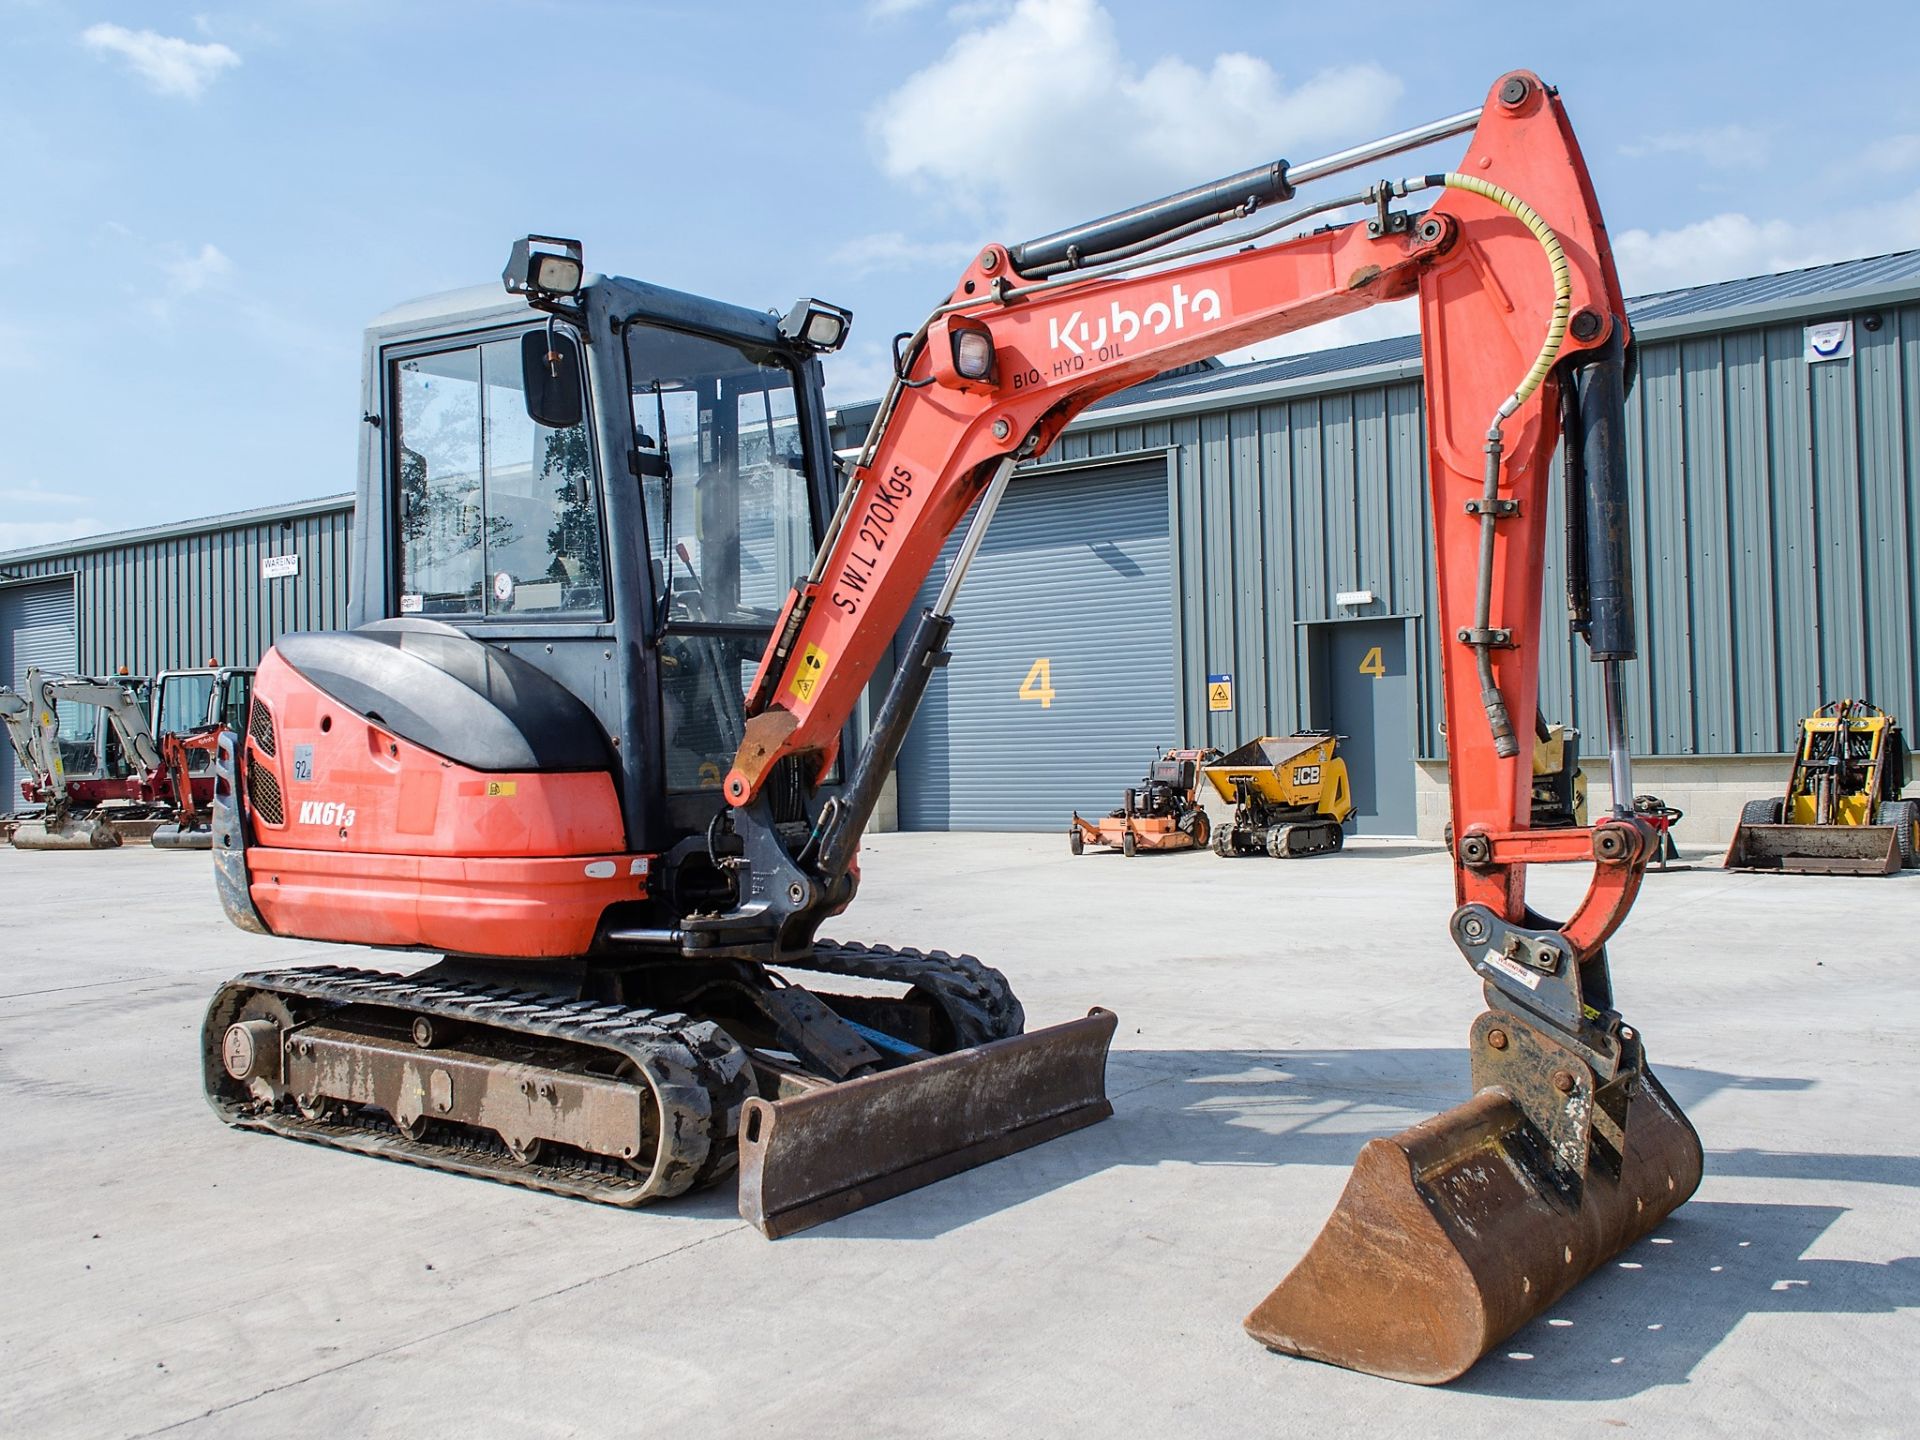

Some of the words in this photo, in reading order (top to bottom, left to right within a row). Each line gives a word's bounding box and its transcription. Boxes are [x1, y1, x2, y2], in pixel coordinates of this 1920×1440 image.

[1049, 284, 1221, 355] Kubota
[1013, 368, 1040, 389] BIO
[1053, 355, 1084, 377] HYD
[1098, 343, 1124, 362] OIL
[832, 551, 877, 615] S.W.L
[859, 465, 912, 551] 270Kgs
[265, 556, 296, 568] WAREING
[1359, 647, 1386, 679] 4
[1019, 658, 1056, 708] 4
[295, 760, 306, 779] 92
[1293, 766, 1320, 785] JCB
